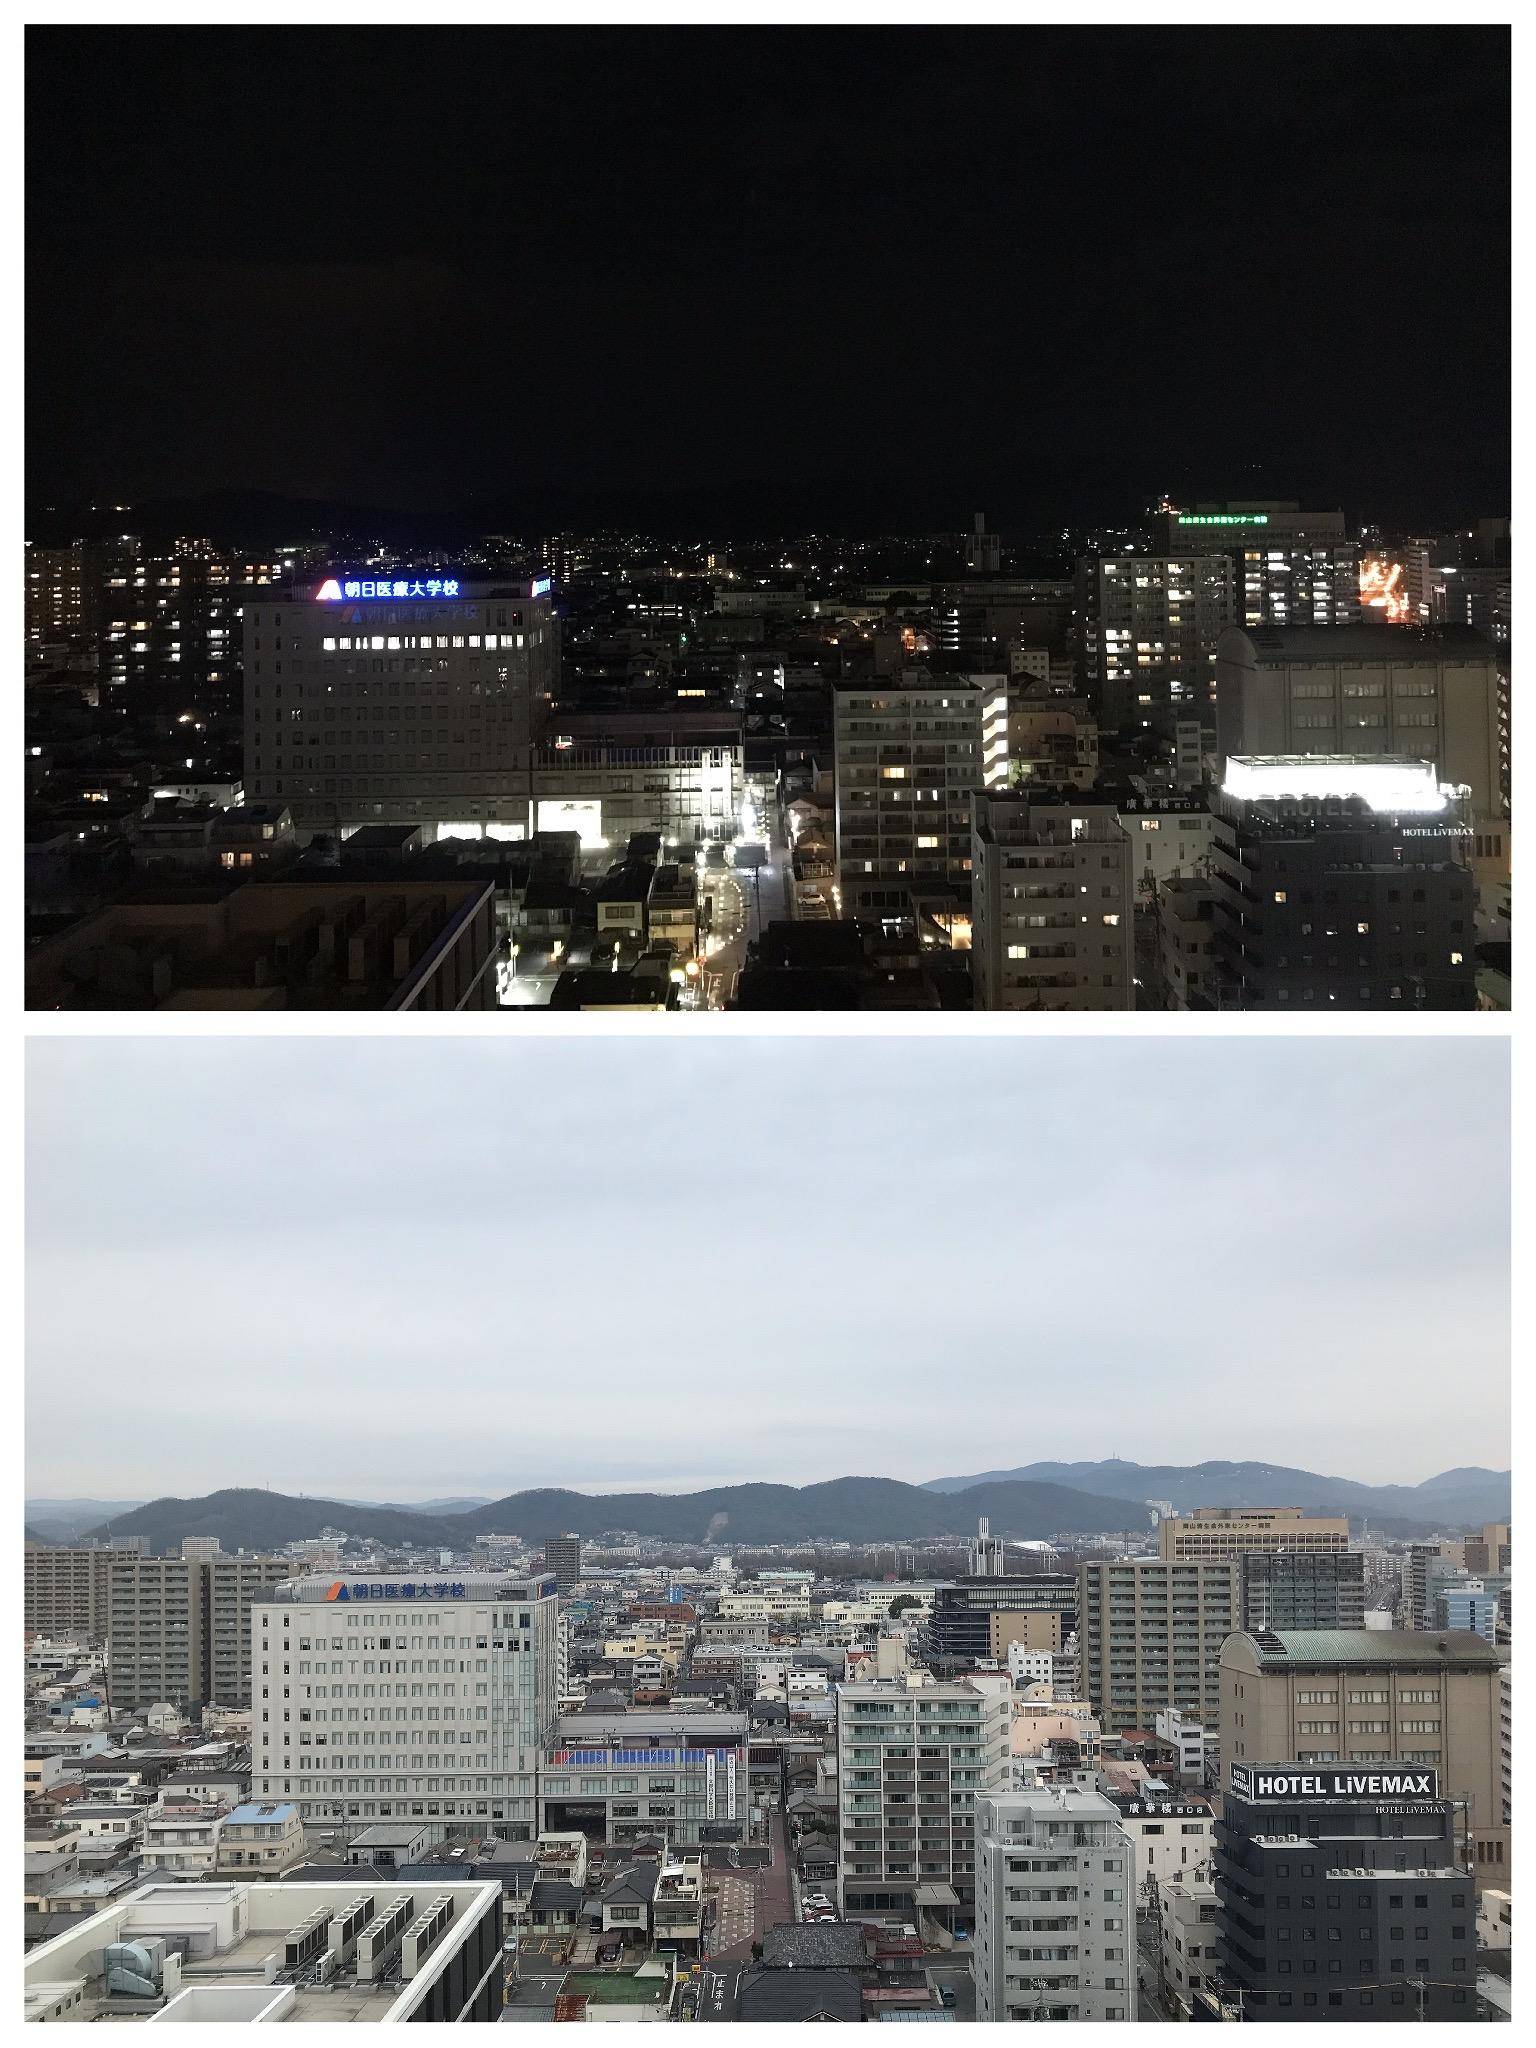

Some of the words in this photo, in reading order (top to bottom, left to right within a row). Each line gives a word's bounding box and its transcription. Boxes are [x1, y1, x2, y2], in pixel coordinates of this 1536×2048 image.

[344, 581, 459, 597] 朝日医療大学校
[1402, 828, 1433, 837] HOTEL
[352, 1582, 466, 1598] 朝日医療大学校
[1233, 1768, 1247, 1781] HOTEL
[1258, 1776, 1327, 1794] HOTEL
[1334, 1775, 1431, 1794] LiVEMAX
[1375, 1806, 1405, 1814] HOTEL
[713, 1978, 726, 2011] 止まれ
